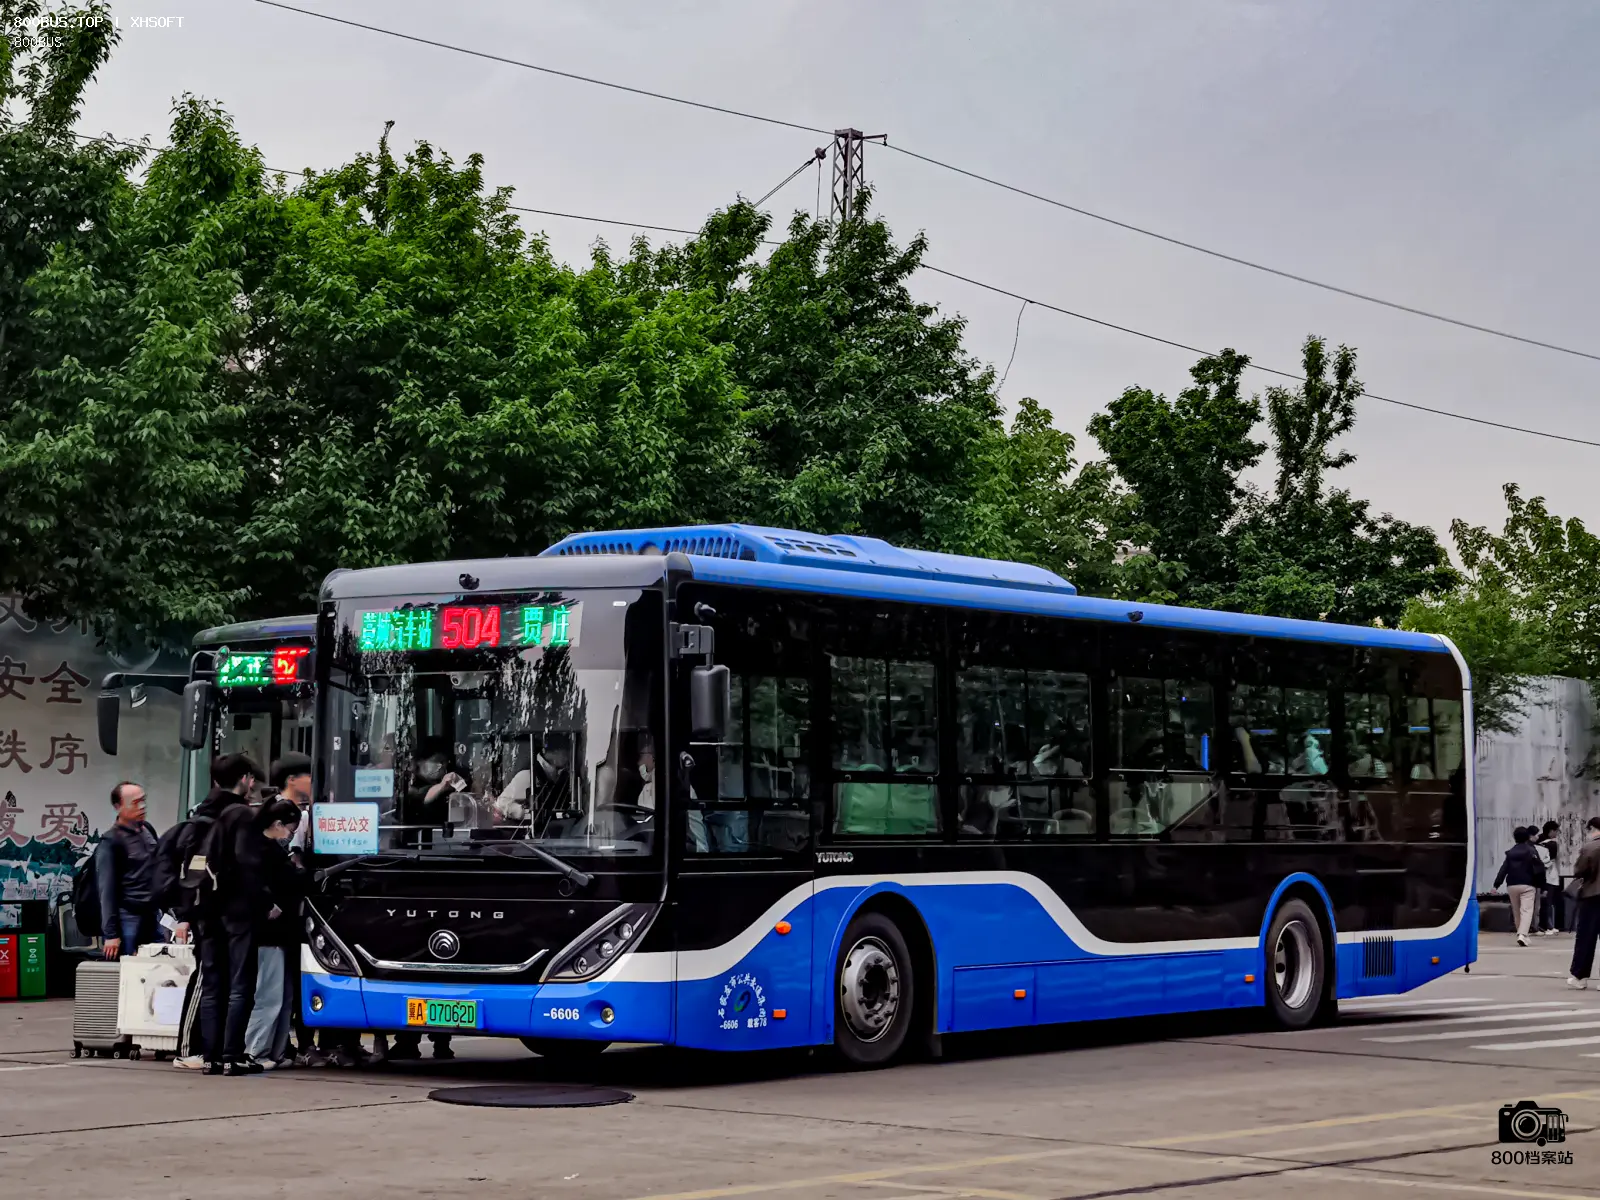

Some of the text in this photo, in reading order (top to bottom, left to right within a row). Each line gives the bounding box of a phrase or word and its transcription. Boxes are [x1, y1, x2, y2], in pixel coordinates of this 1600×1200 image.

[442, 605, 501, 648] 504
[523, 605, 571, 645] 贾庄
[0, 655, 91, 703] 安全
[317, 816, 370, 832] 响应式公交
[386, 909, 505, 919] YUTONG
[543, 1007, 580, 1021] -6606
